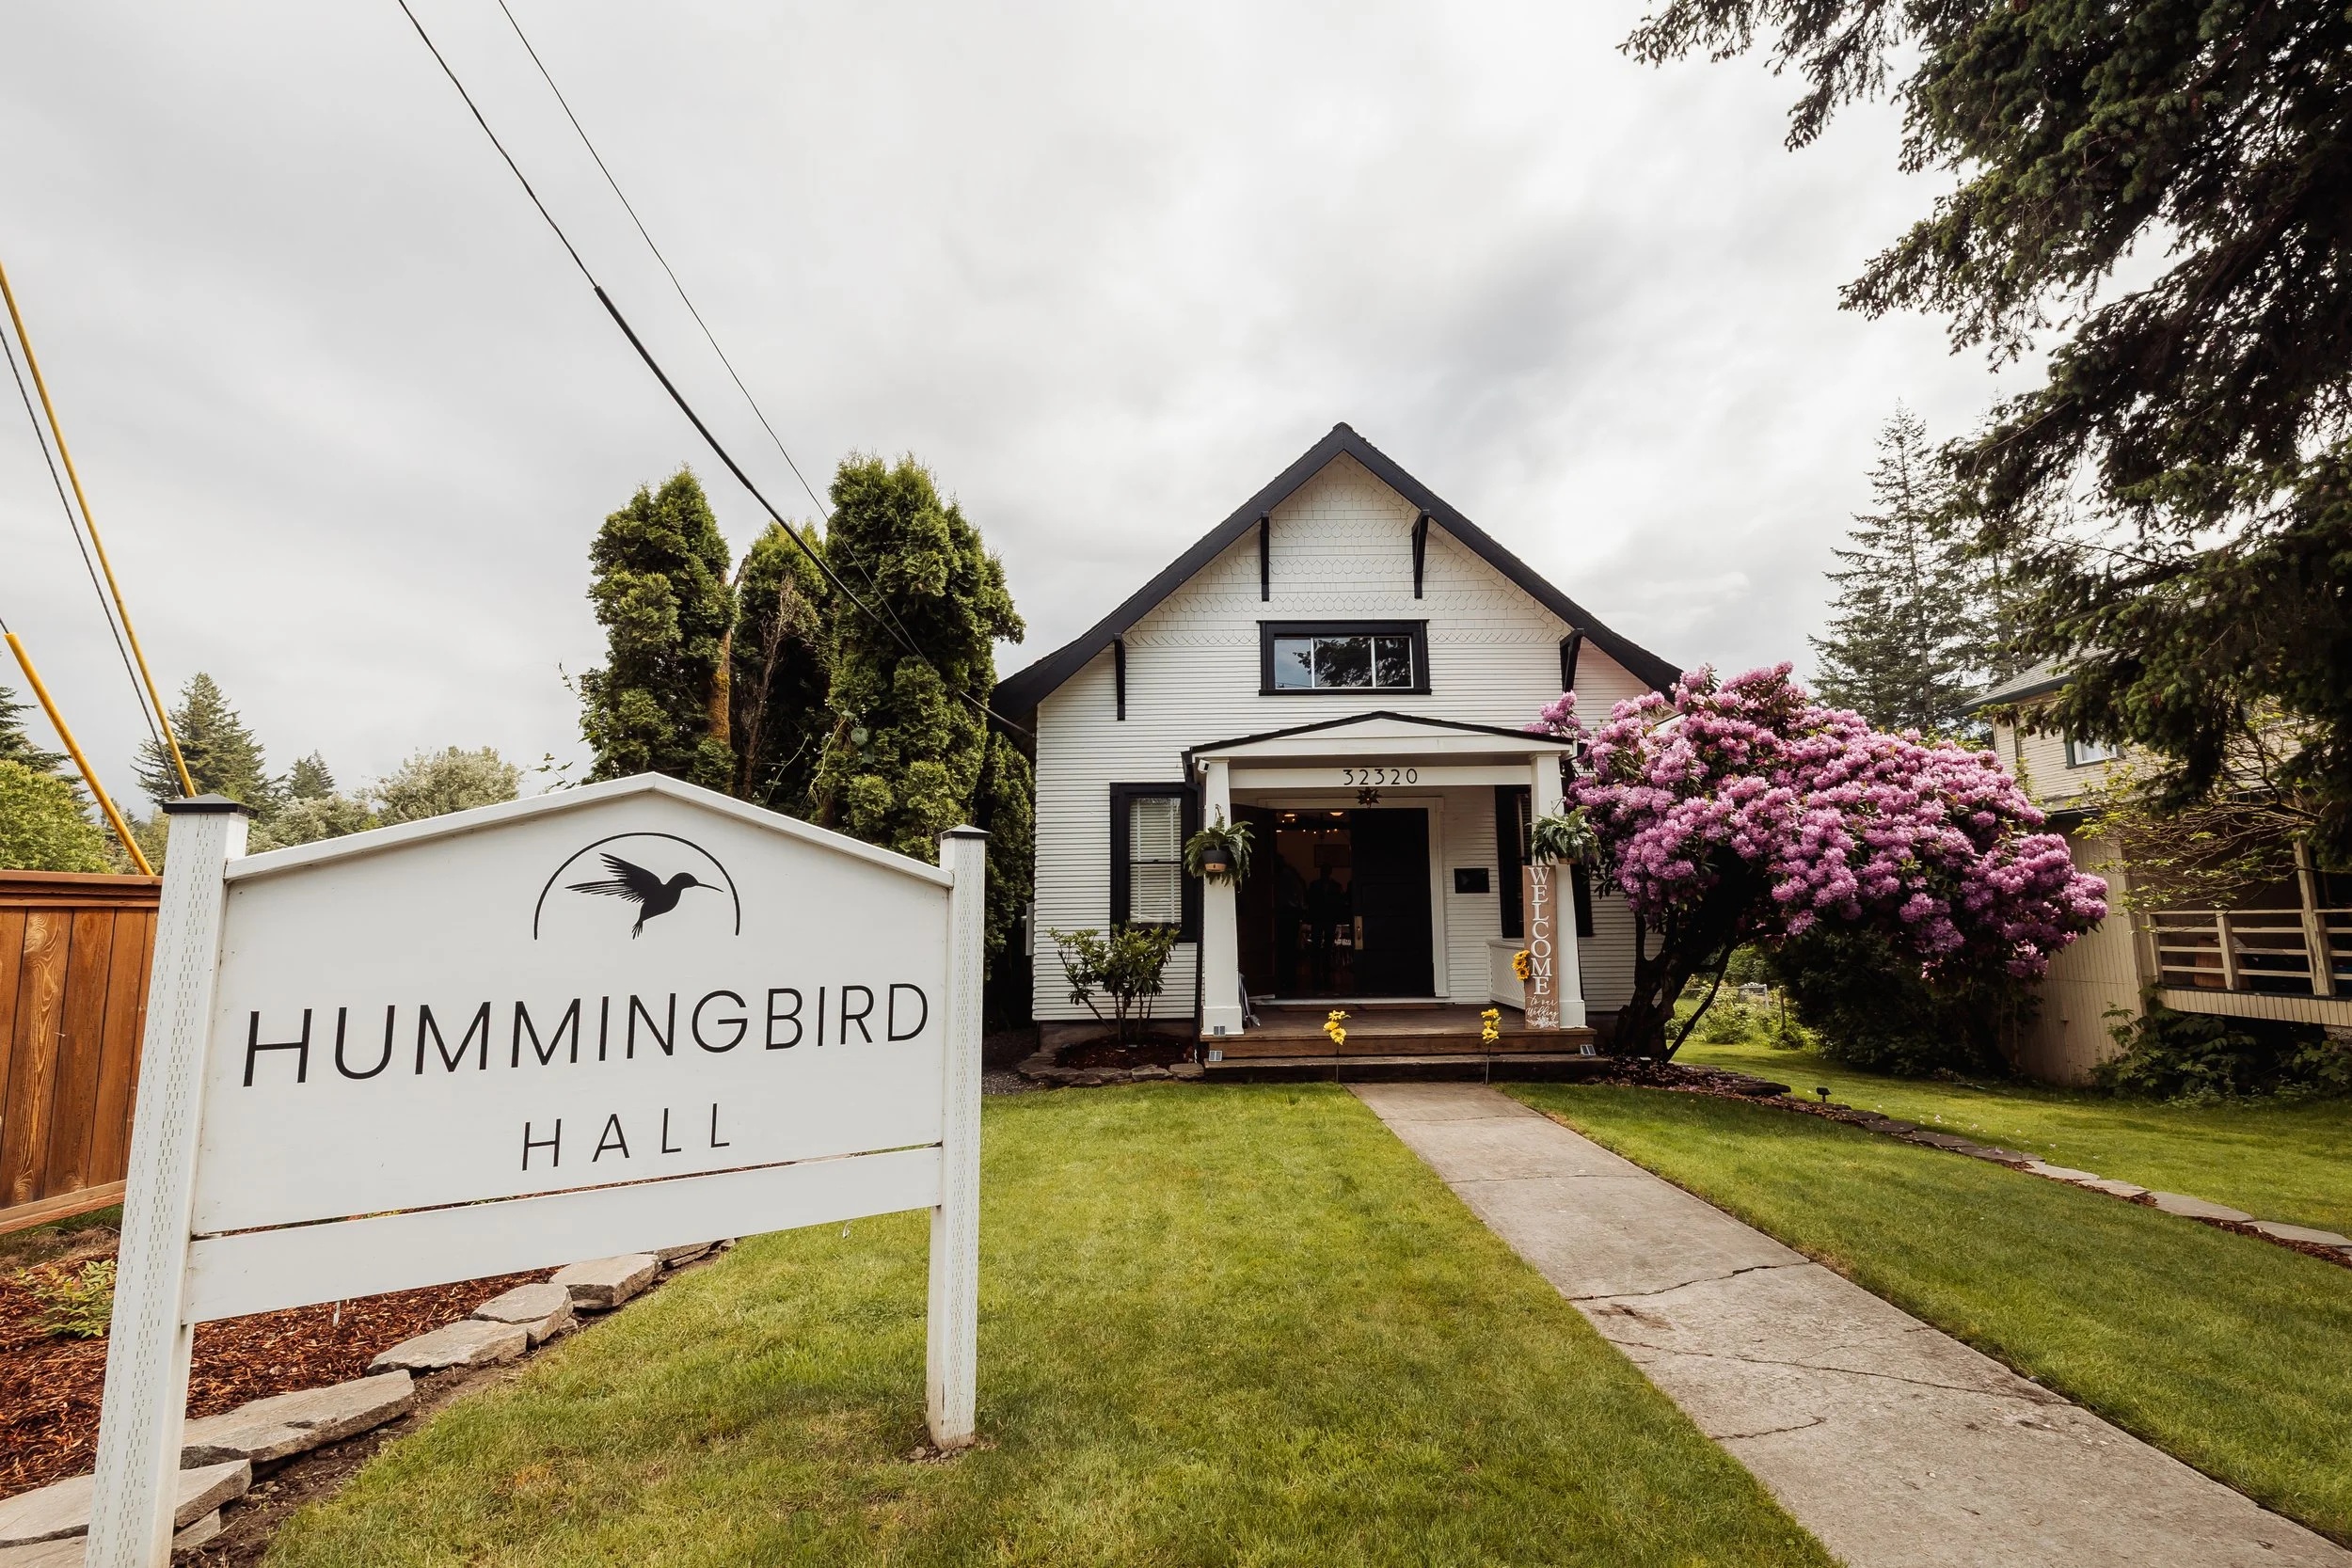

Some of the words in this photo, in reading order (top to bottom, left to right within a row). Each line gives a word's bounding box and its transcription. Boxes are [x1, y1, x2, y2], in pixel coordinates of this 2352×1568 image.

[1343, 768, 1418, 785] 32320
[1528, 866, 1552, 995] WELCOME
[243, 983, 929, 1087] HUMMINGBIRD
[522, 1102, 730, 1171] HALL
